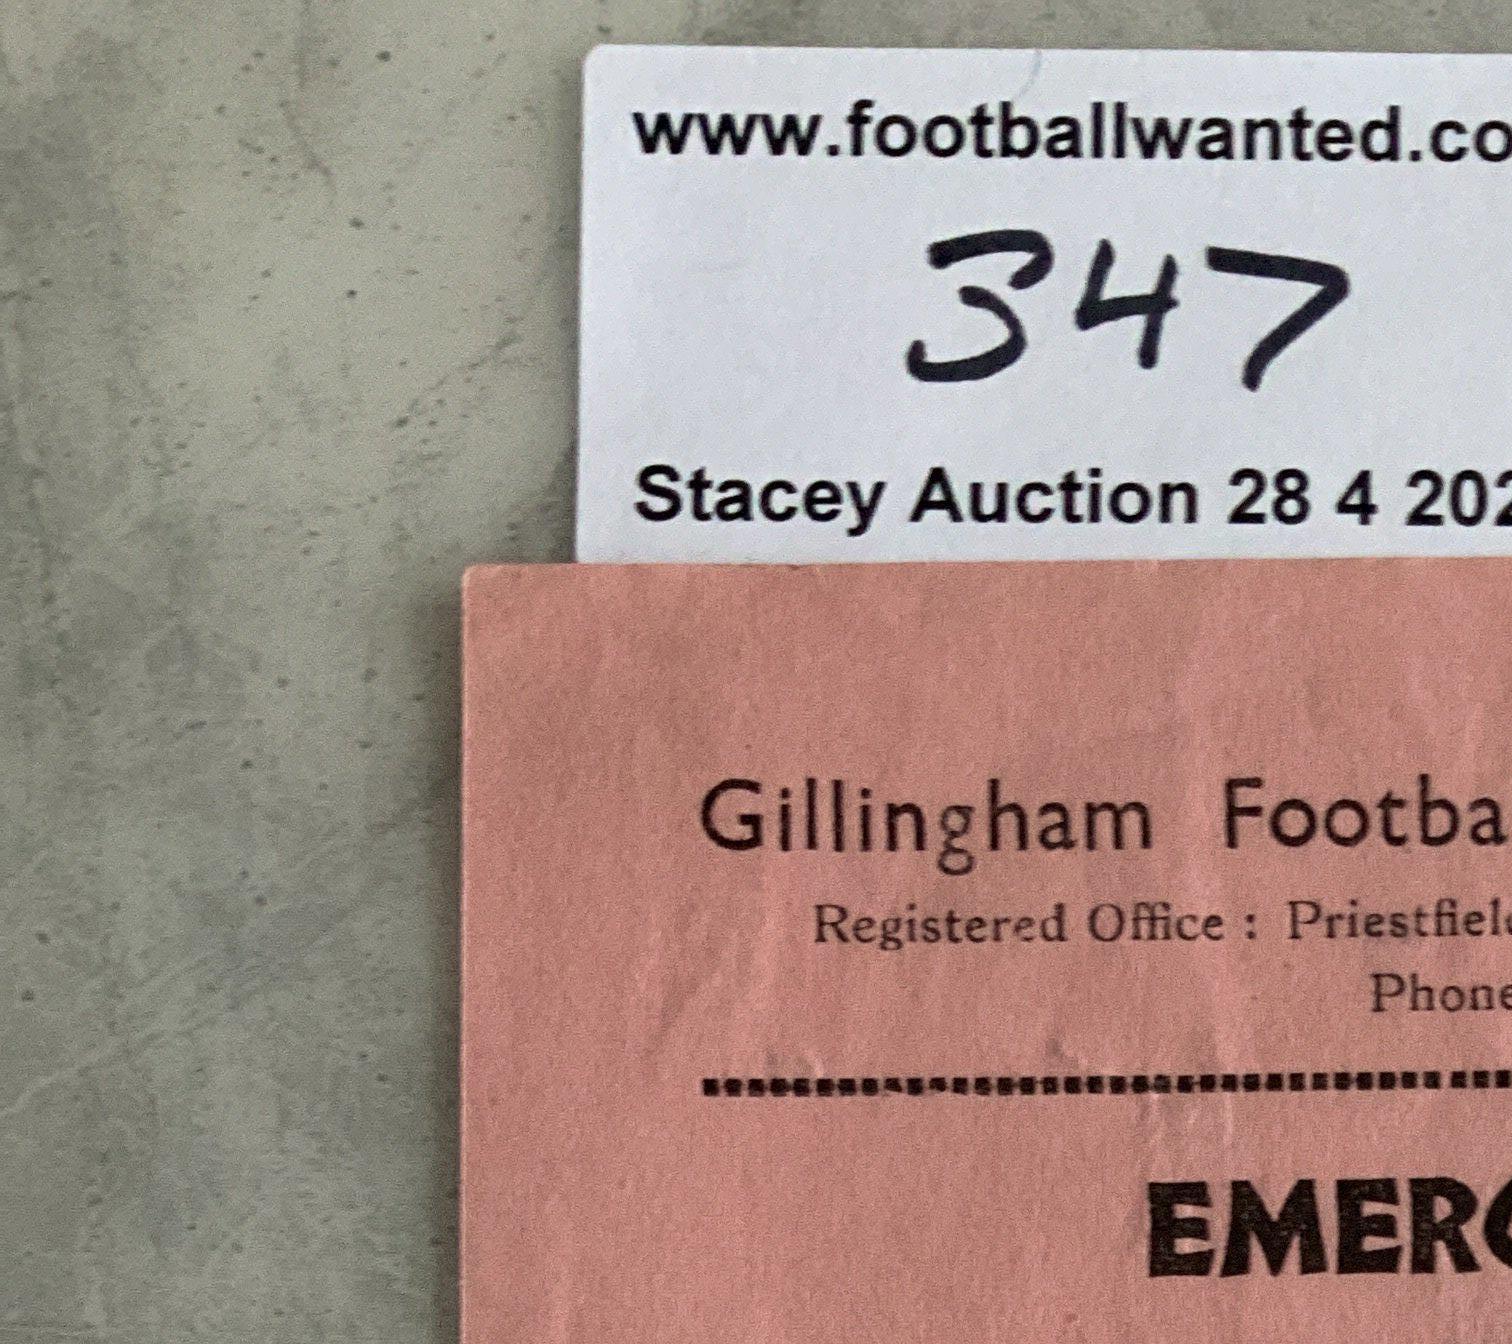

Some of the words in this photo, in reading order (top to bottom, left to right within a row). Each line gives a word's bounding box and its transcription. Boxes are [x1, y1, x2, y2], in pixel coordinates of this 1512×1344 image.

[906, 230, 1349, 391] 347
[635, 465, 885, 537] Stacey
[910, 467, 1197, 524] Auction
[1229, 468, 1310, 525] 28
[1336, 470, 1377, 525] 4
[701, 778, 1151, 876] Gillingham
[815, 903, 1067, 951] Registered
[1088, 902, 1223, 942] Office
